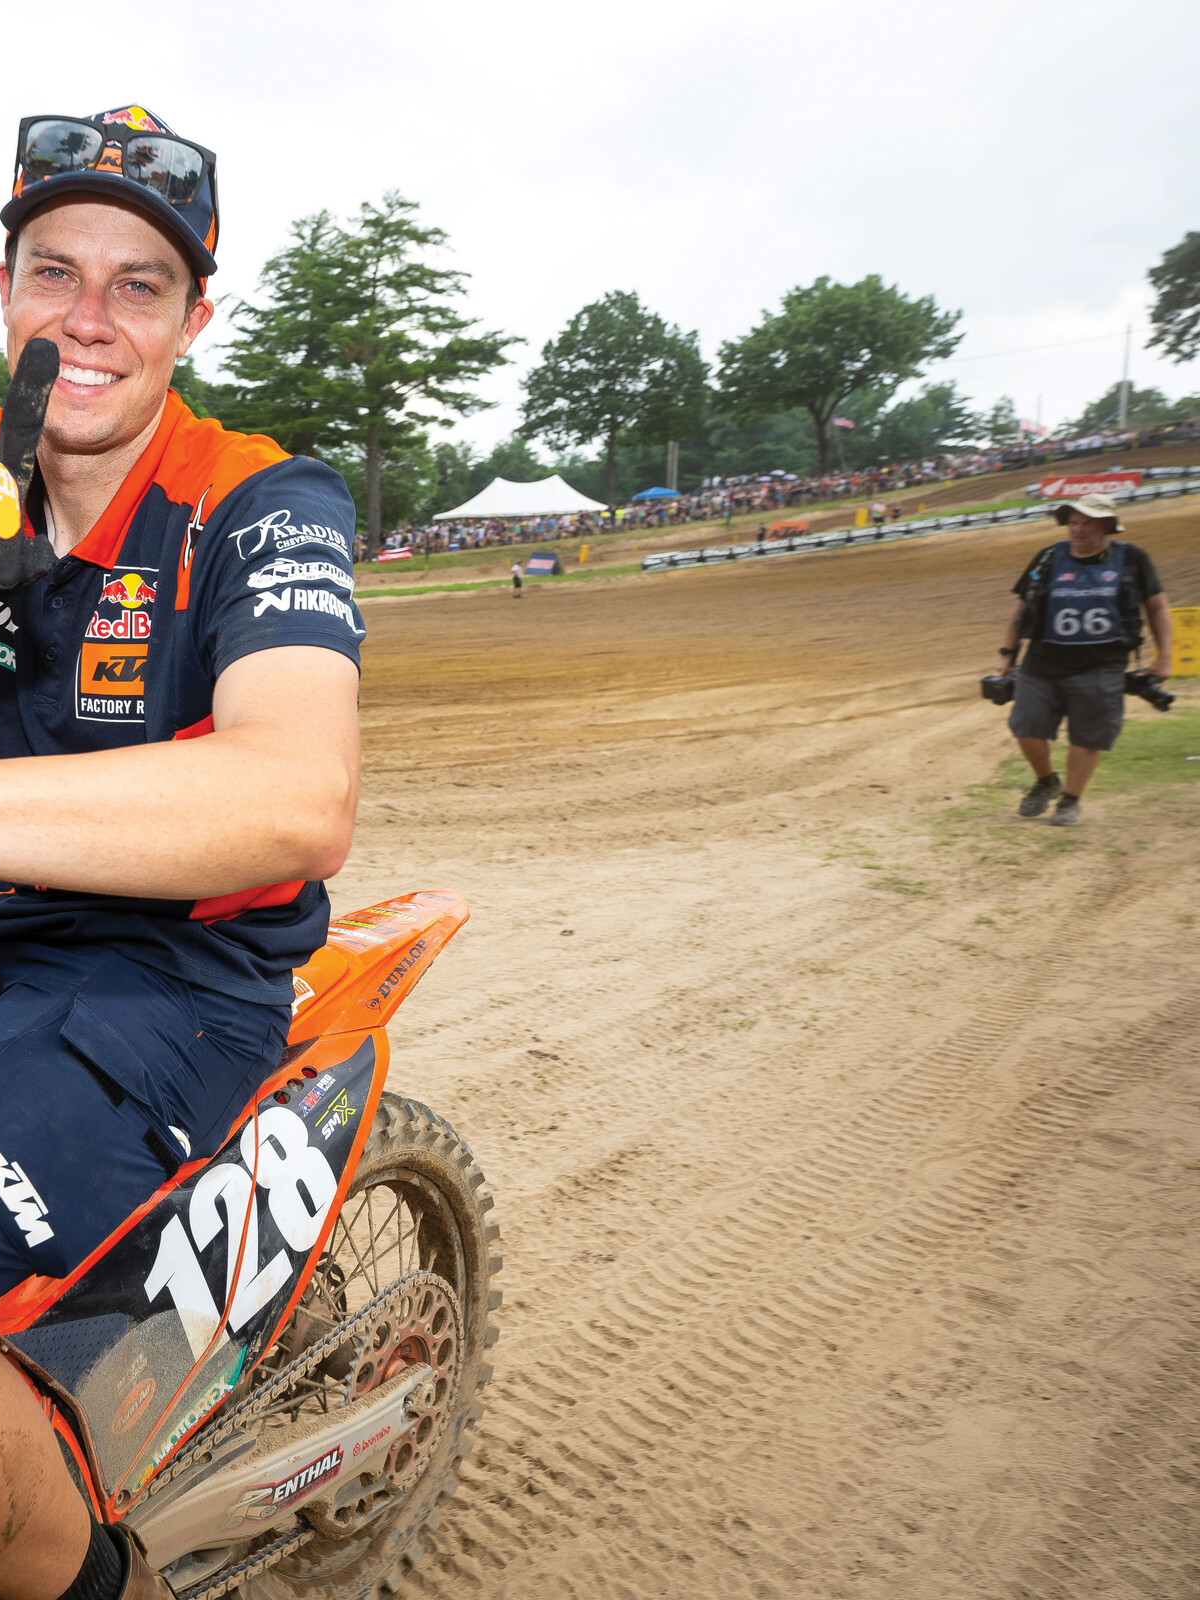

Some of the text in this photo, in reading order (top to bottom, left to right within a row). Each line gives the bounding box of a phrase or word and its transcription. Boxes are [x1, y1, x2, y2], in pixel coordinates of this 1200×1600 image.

[1061, 480, 1135, 496] HONDA
[84, 610, 131, 639] Red
[1053, 607, 1113, 637] 66
[80, 697, 131, 715] FACTORY
[376, 939, 428, 999] DUNLOP
[299, 1074, 332, 1117] AMA PRO
[321, 1094, 357, 1141] SMX
[143, 1106, 339, 1361] 128
[138, 1382, 152, 1404] Air
[153, 1375, 235, 1467] MOTOREX
[361, 1425, 391, 1452] brembo
